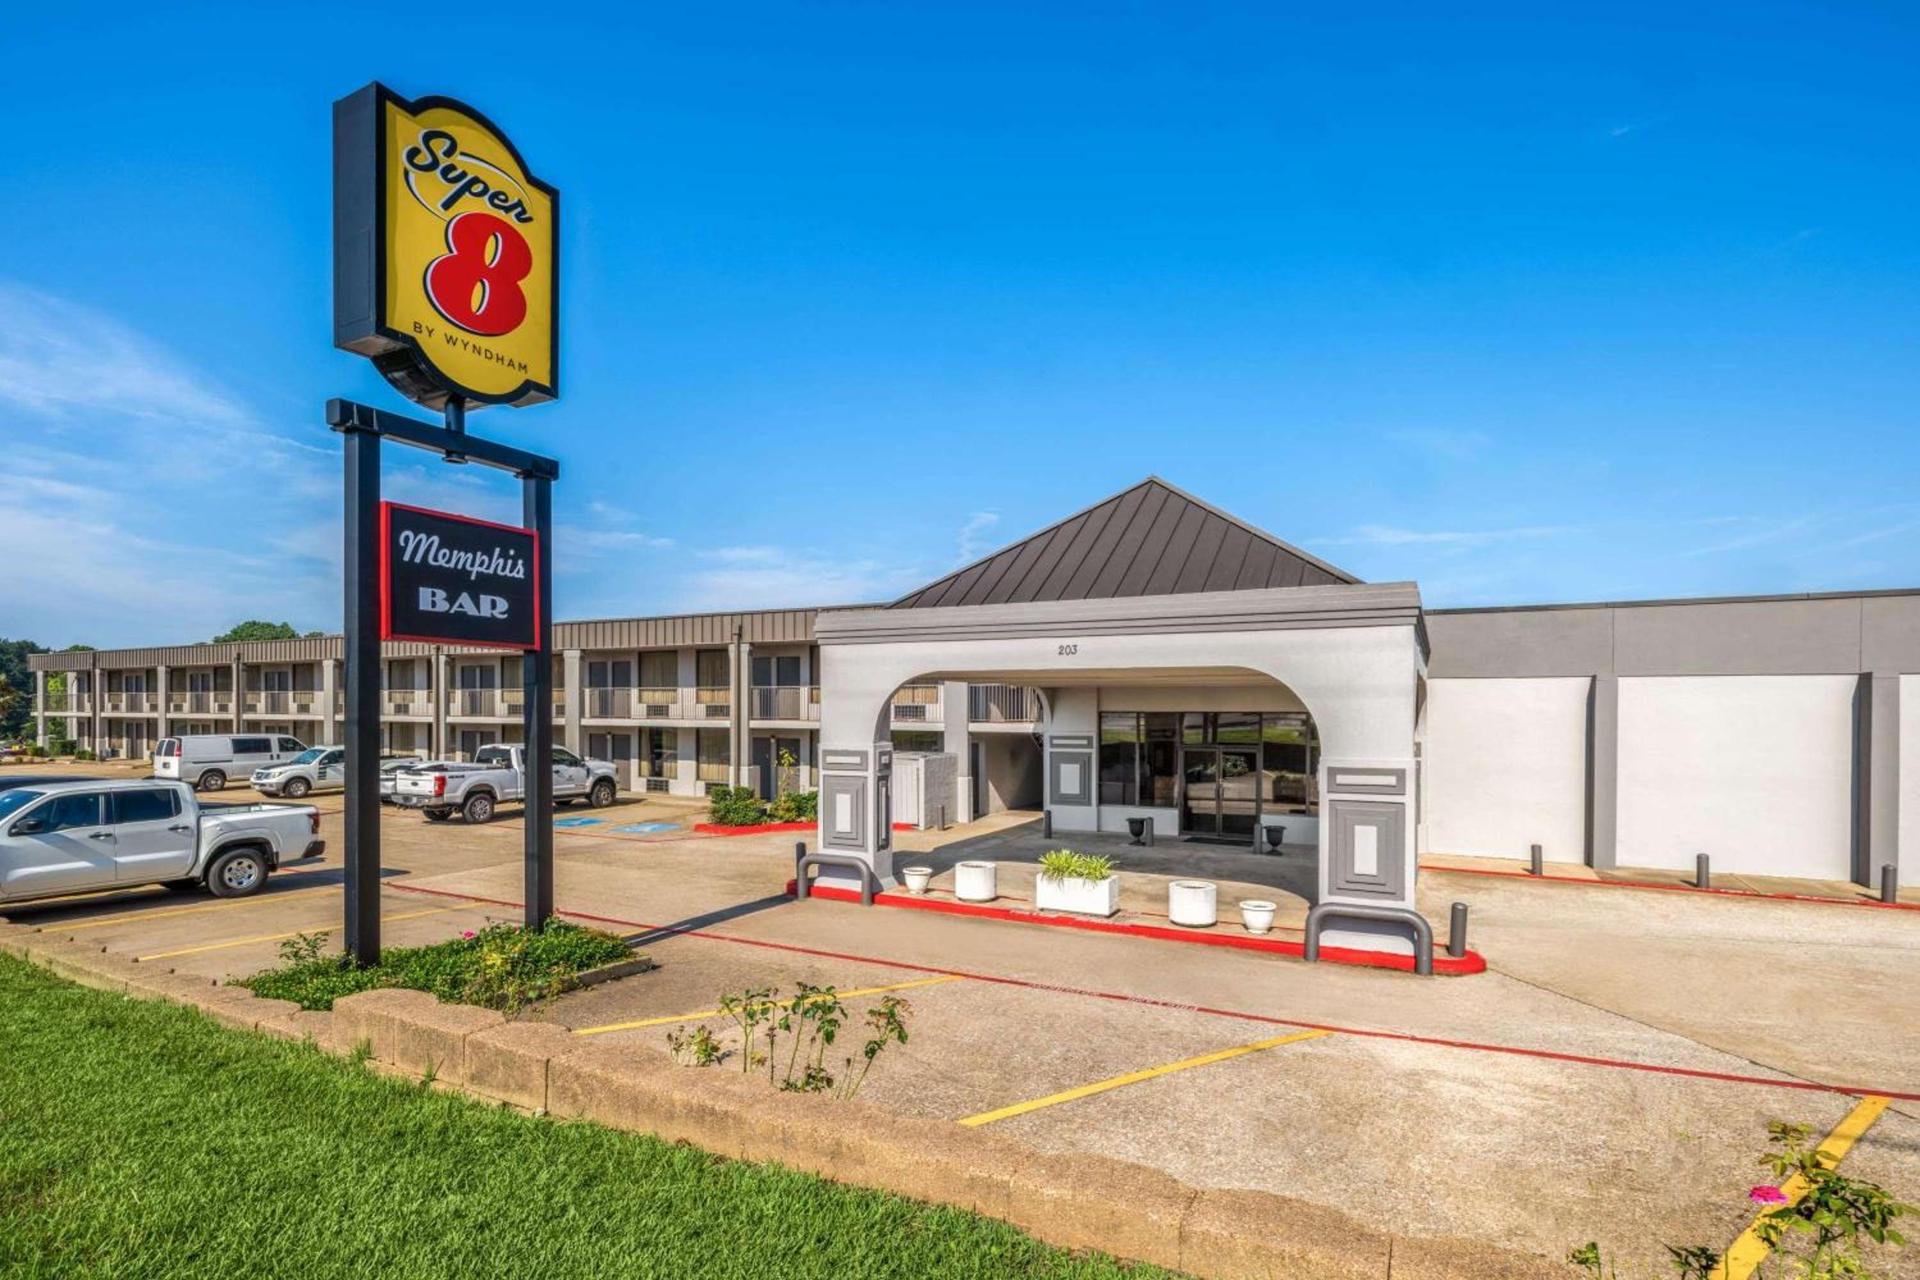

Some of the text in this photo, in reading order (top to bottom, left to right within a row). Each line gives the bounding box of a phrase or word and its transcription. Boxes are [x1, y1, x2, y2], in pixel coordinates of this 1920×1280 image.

[405, 129, 533, 224] Super
[424, 211, 533, 337] 8
[413, 321, 529, 375] BY WYNDHAM
[399, 530, 525, 580] Memphis
[419, 587, 509, 619] BAR
[1058, 644, 1078, 656] 203
